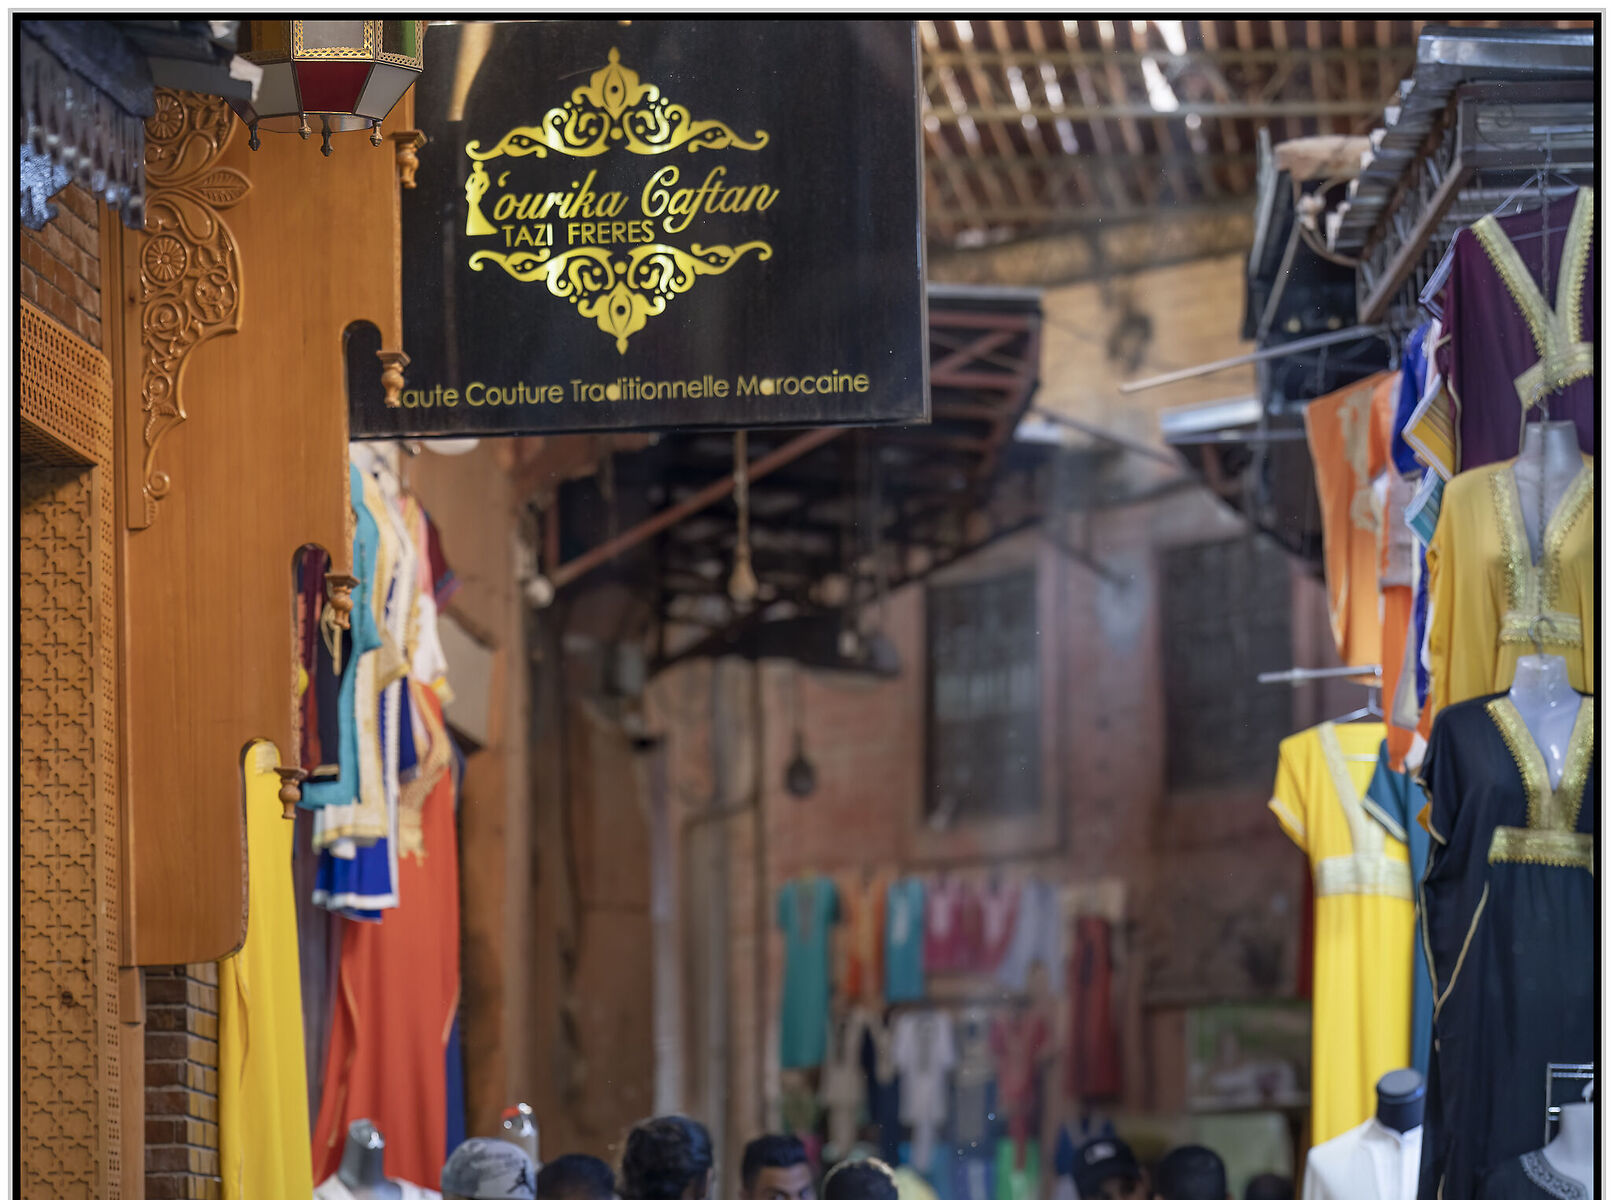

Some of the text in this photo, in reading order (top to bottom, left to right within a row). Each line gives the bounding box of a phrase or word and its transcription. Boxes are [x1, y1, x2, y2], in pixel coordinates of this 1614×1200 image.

[641, 165, 780, 234] Caftan
[502, 219, 655, 247] TAZI FRERES
[400, 369, 869, 408] aute Couture Traditionnelle Marocaine
